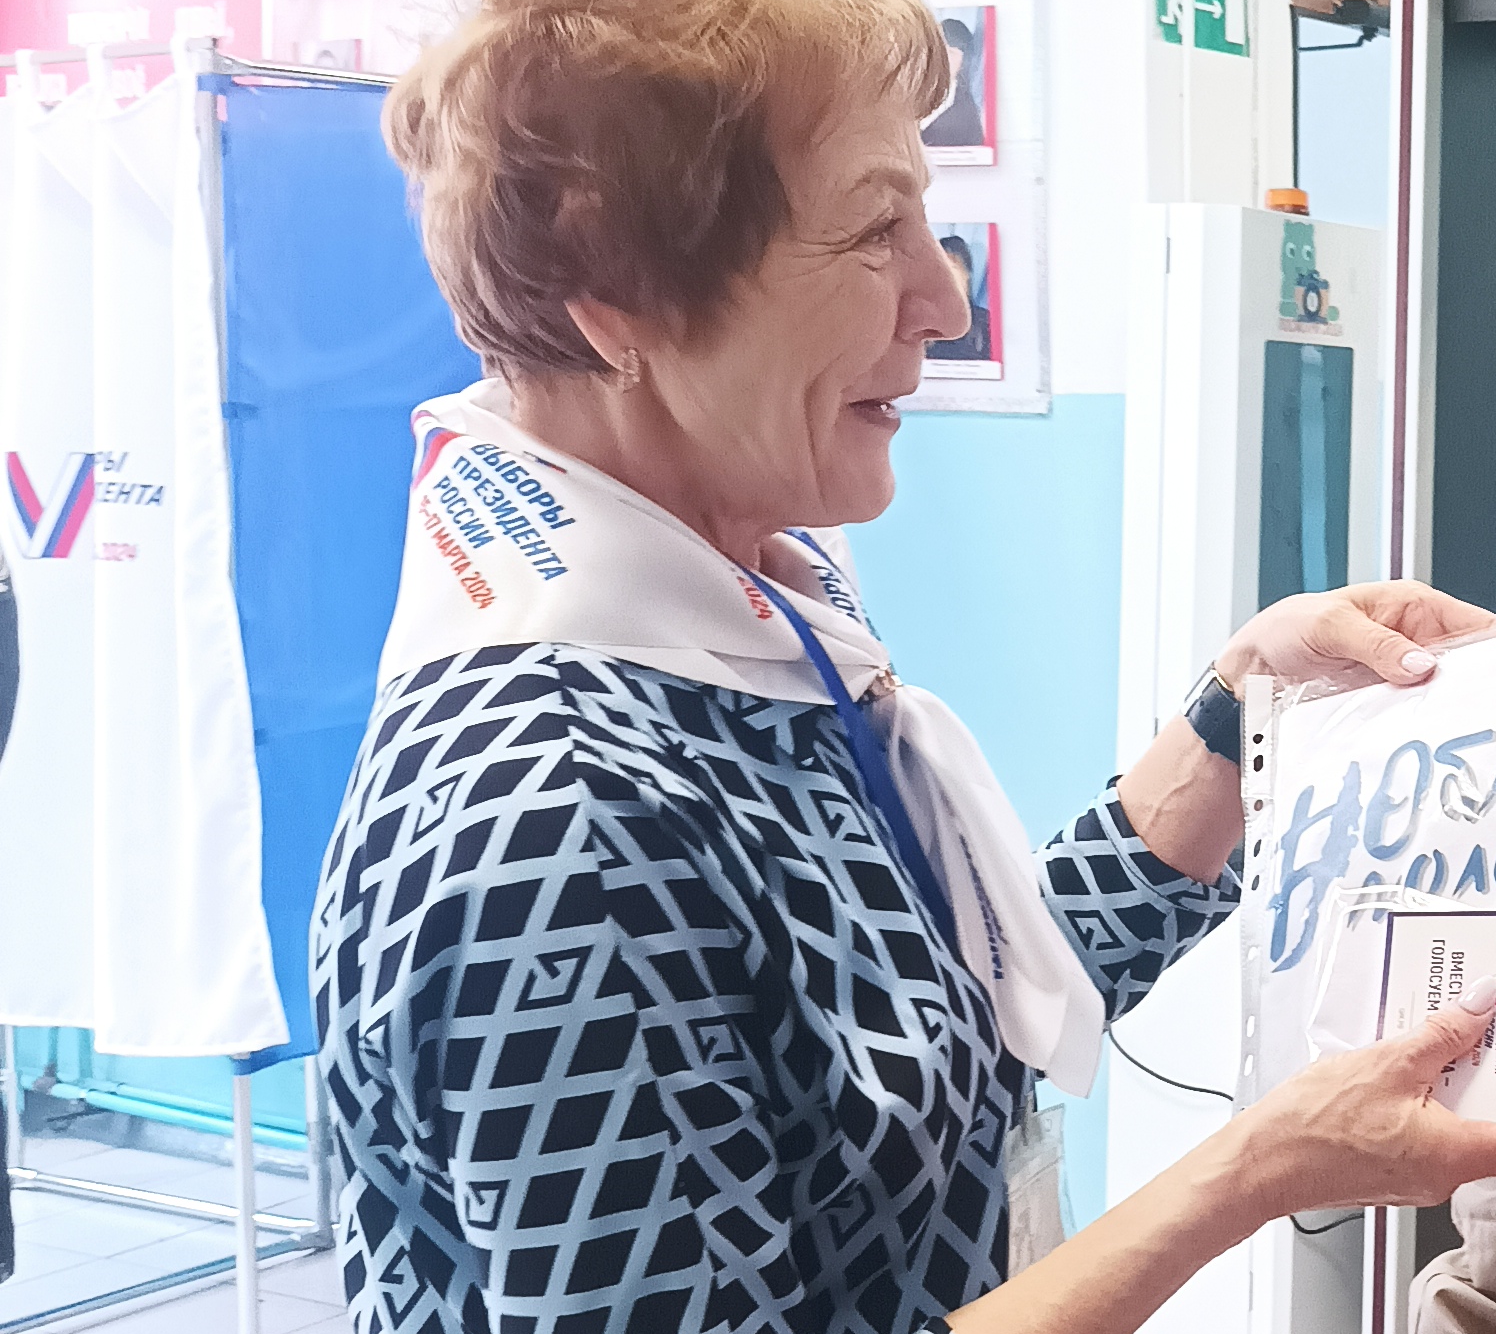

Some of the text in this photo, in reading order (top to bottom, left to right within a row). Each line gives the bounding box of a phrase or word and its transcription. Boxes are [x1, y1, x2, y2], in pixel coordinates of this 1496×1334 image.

[433, 475, 496, 549] РОССИИ
[451, 455, 569, 581] ПРЕЗИДЕНТА
[470, 443, 576, 530] ВЫБОРЫ
[460, 571, 498, 610] 2024
[1427, 939, 1446, 1011] ГОЛОСУЕМ
[1448, 951, 1465, 1002] ВМЕСТ
